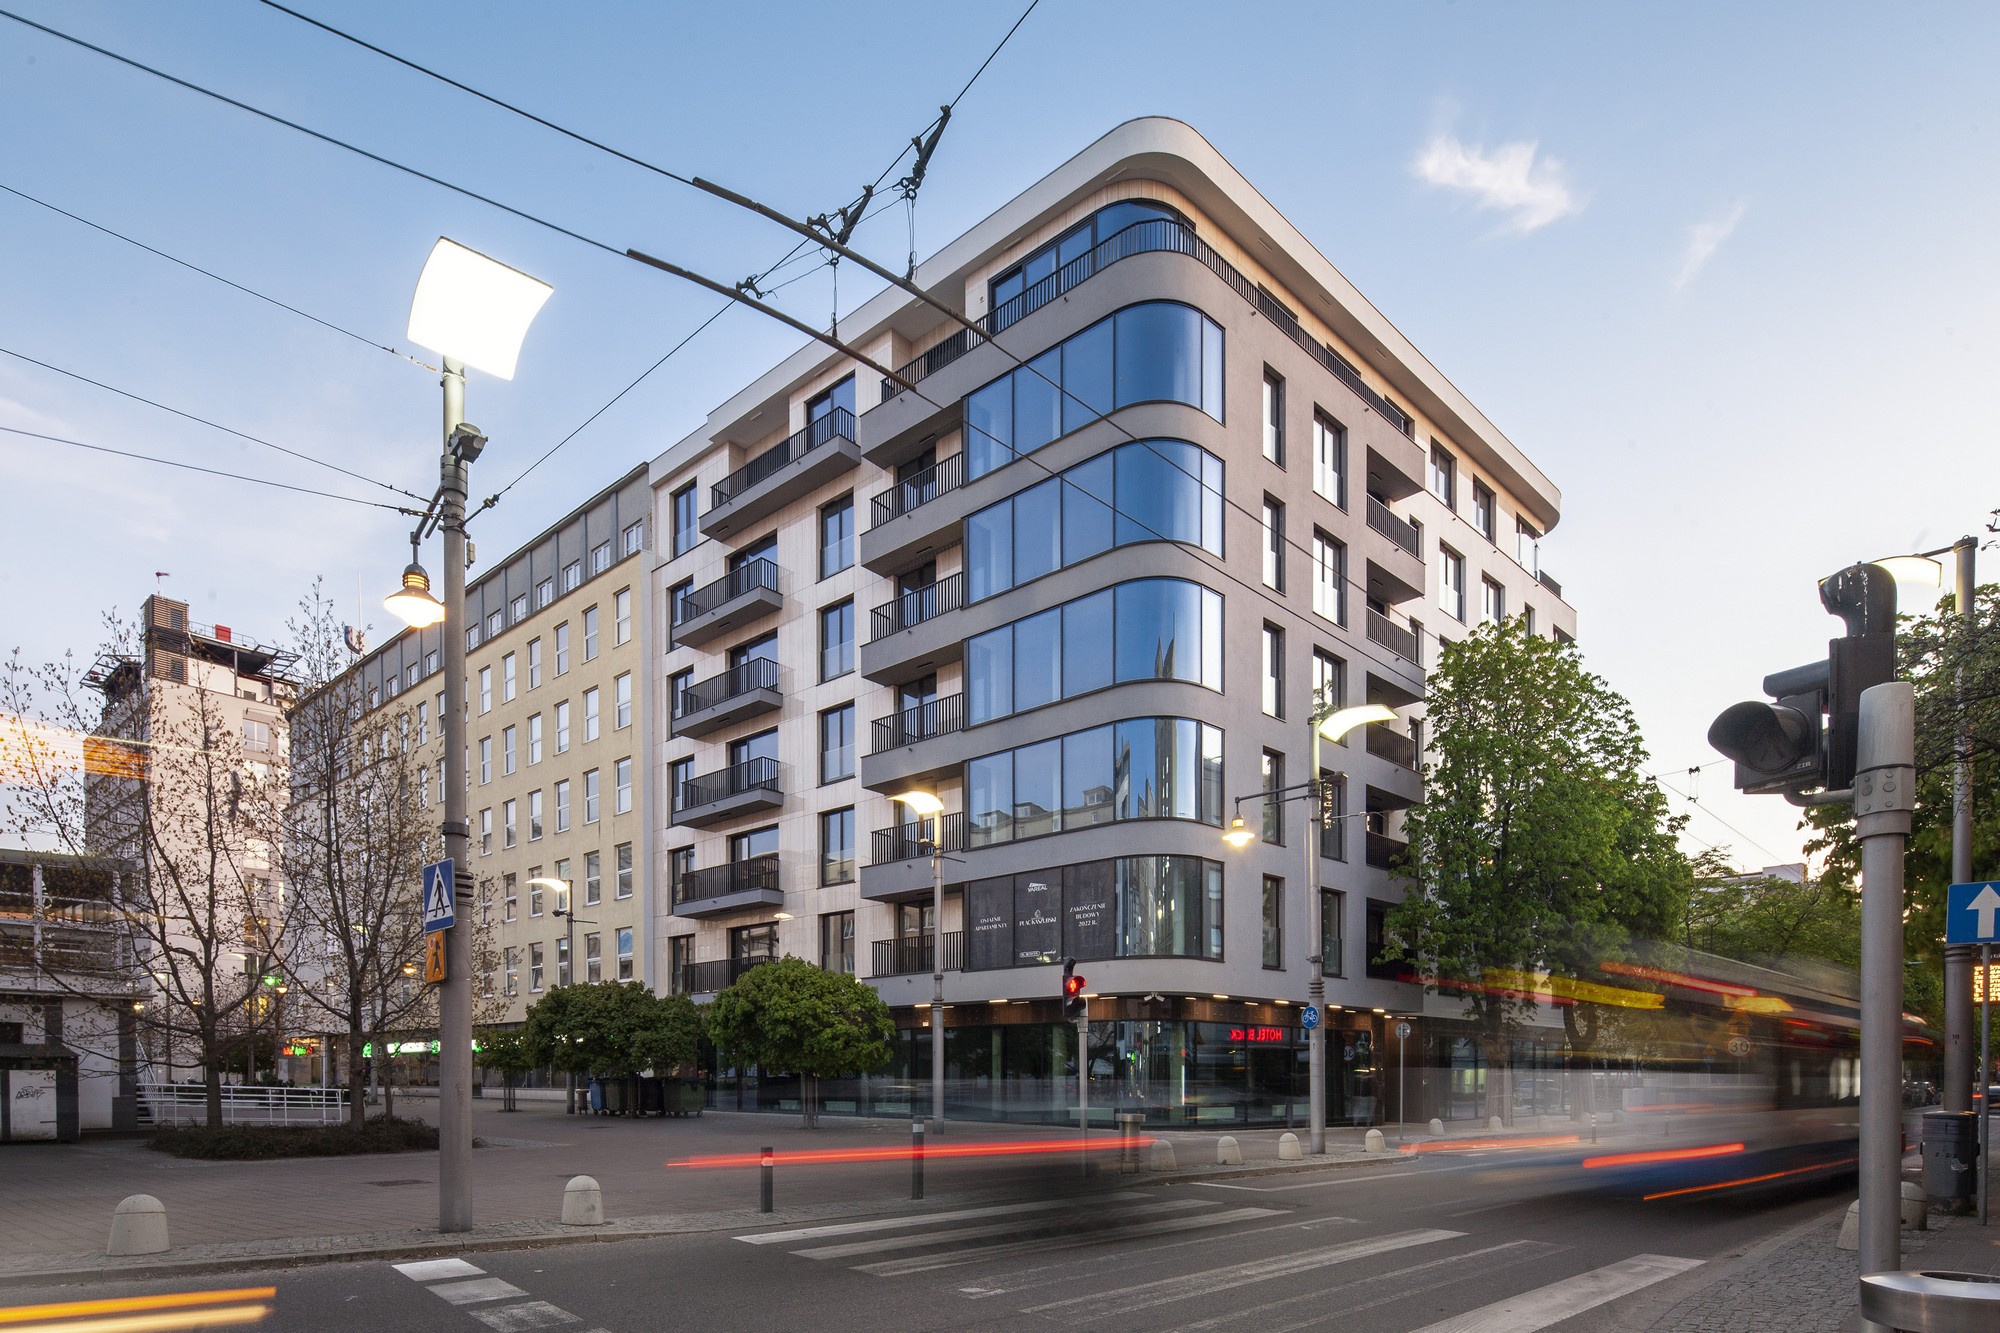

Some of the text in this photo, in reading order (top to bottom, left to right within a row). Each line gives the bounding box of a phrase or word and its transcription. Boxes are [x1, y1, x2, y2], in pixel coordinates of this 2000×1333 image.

[1069, 903, 1106, 912] ZAKOŃCZENIE
[975, 923, 1007, 931] APARTAMENTY
[1730, 1041, 1749, 1053] 30
